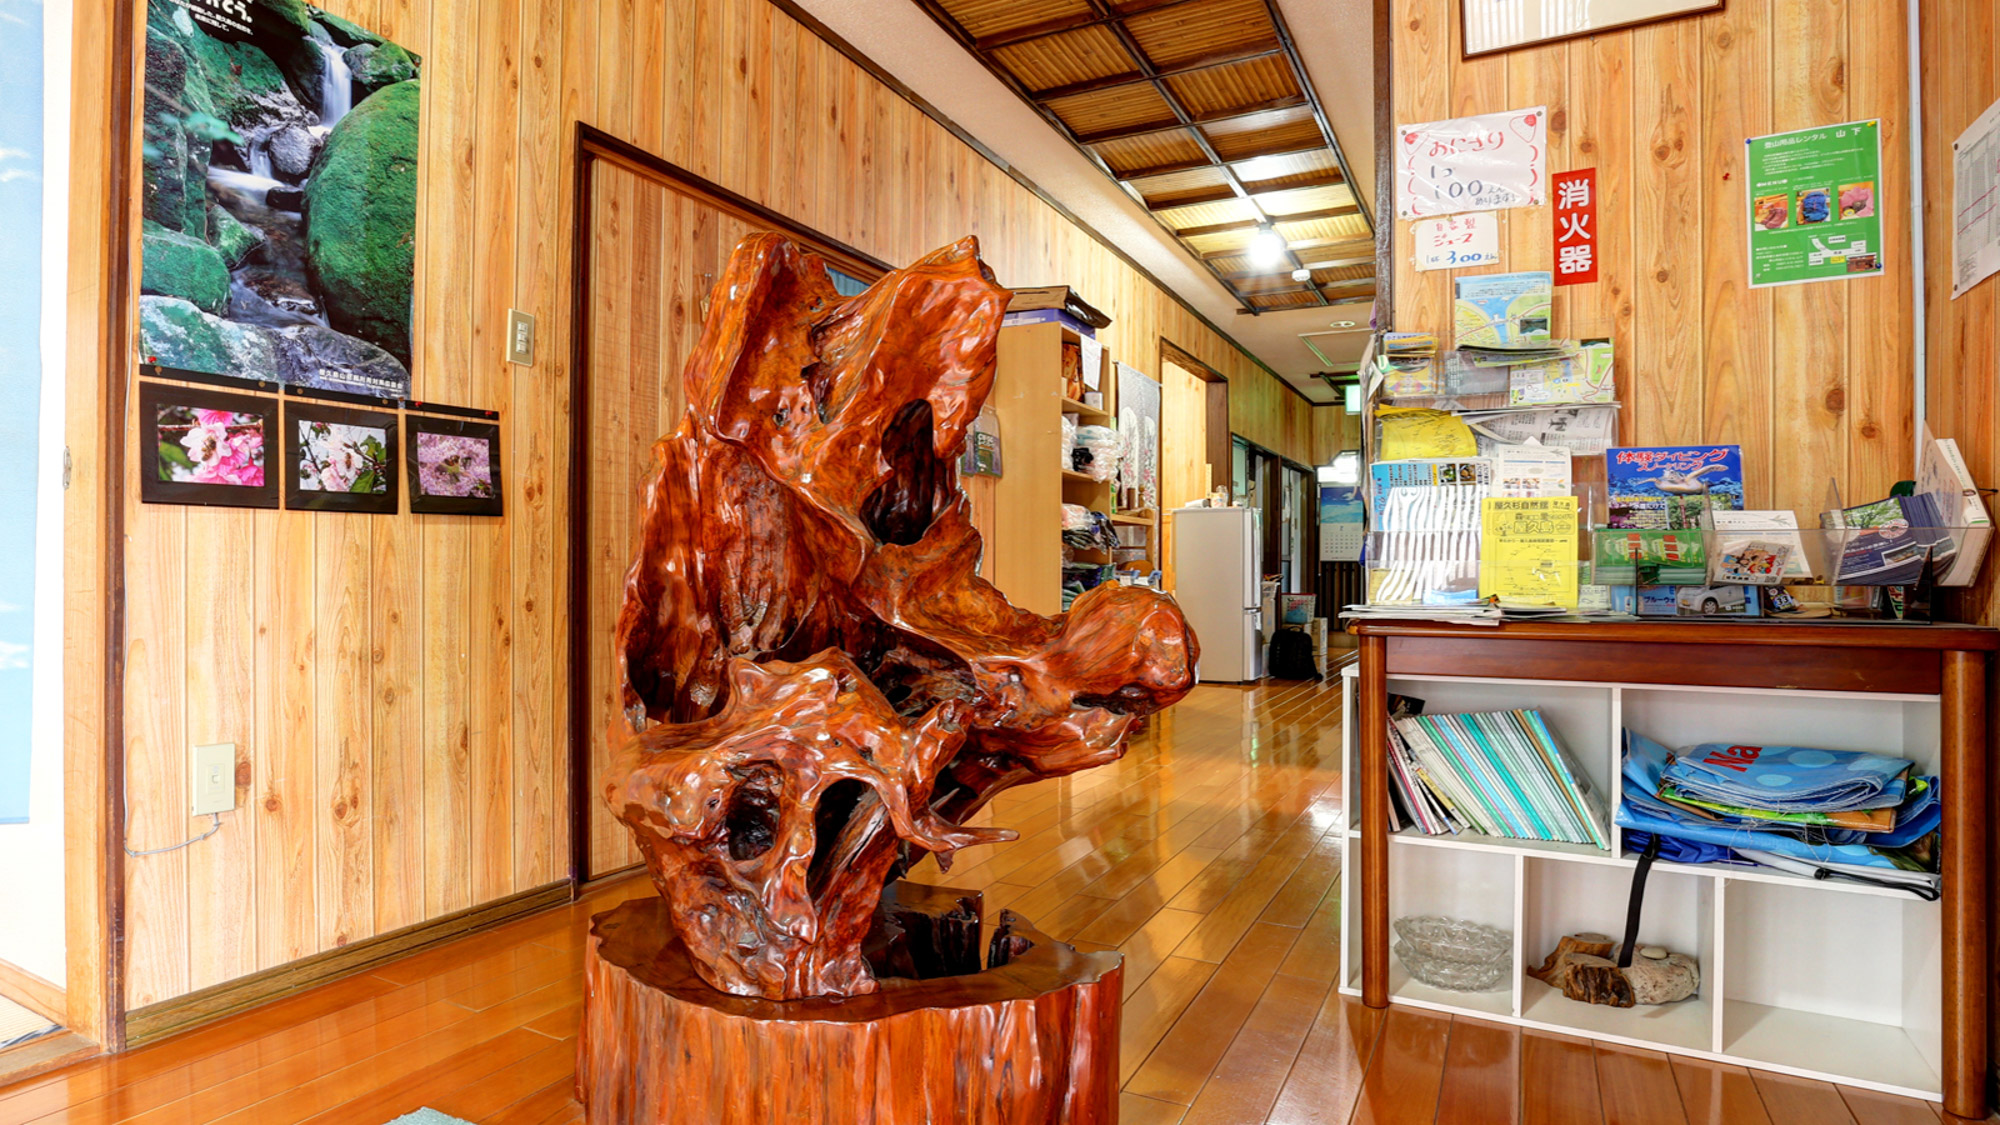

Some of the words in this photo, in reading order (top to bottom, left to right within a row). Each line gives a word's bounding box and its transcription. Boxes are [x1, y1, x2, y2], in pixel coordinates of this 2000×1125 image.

[1763, 132, 1828, 149] 登山用品レンタル
[1557, 178, 1593, 275] 消火器
[1446, 250, 1483, 265] 300
[1615, 447, 1730, 465] 体験ダイビング
